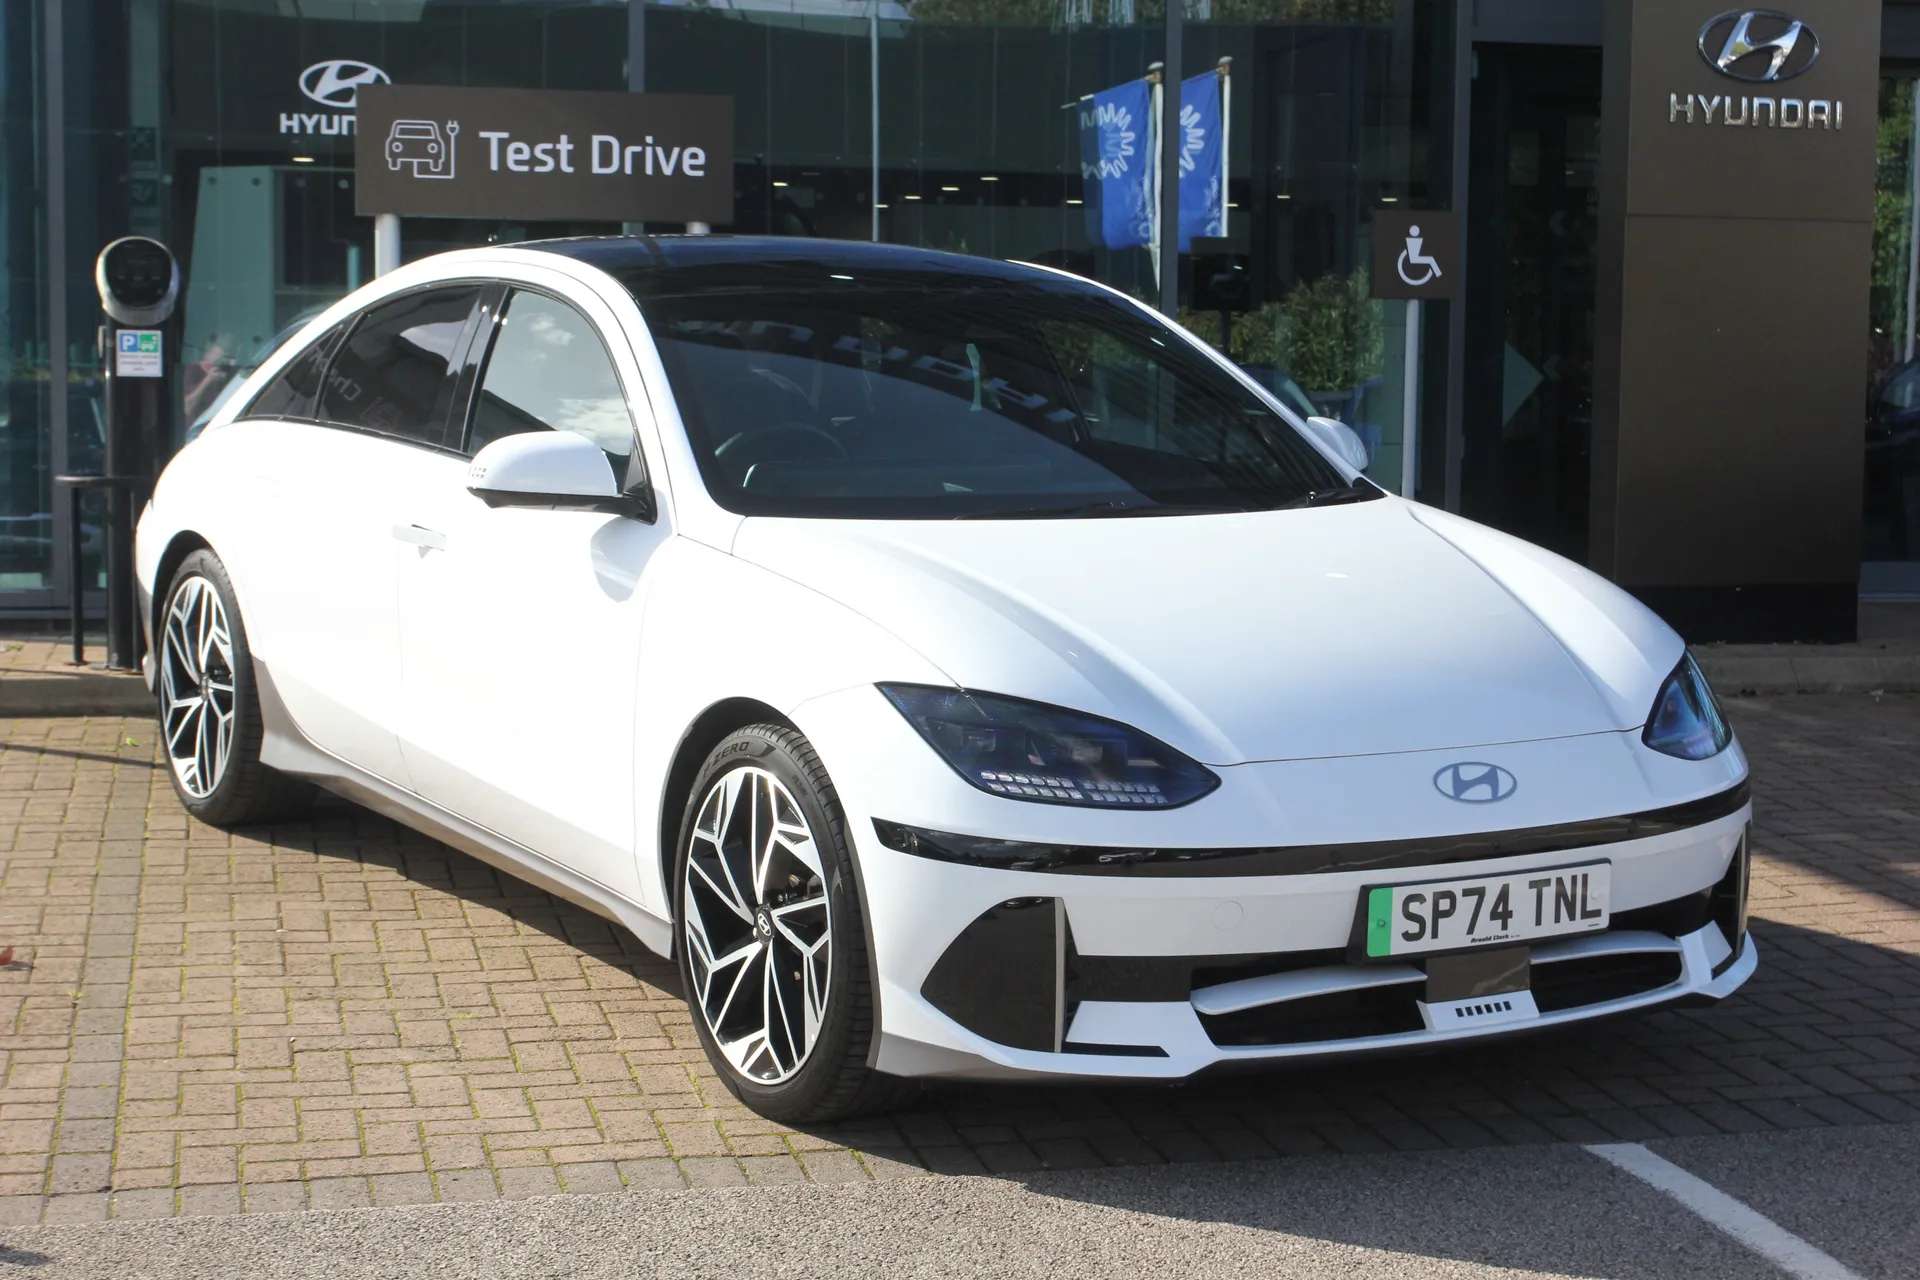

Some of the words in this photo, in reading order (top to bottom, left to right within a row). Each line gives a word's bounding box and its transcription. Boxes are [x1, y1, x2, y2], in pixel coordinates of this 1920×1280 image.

[280, 112, 357, 135] HYUN
[1669, 92, 1843, 130] HYUNDAI
[479, 131, 574, 173] Test
[591, 134, 706, 177] Drive
[1401, 883, 1513, 942] SP74
[1528, 873, 1602, 926] TNL
